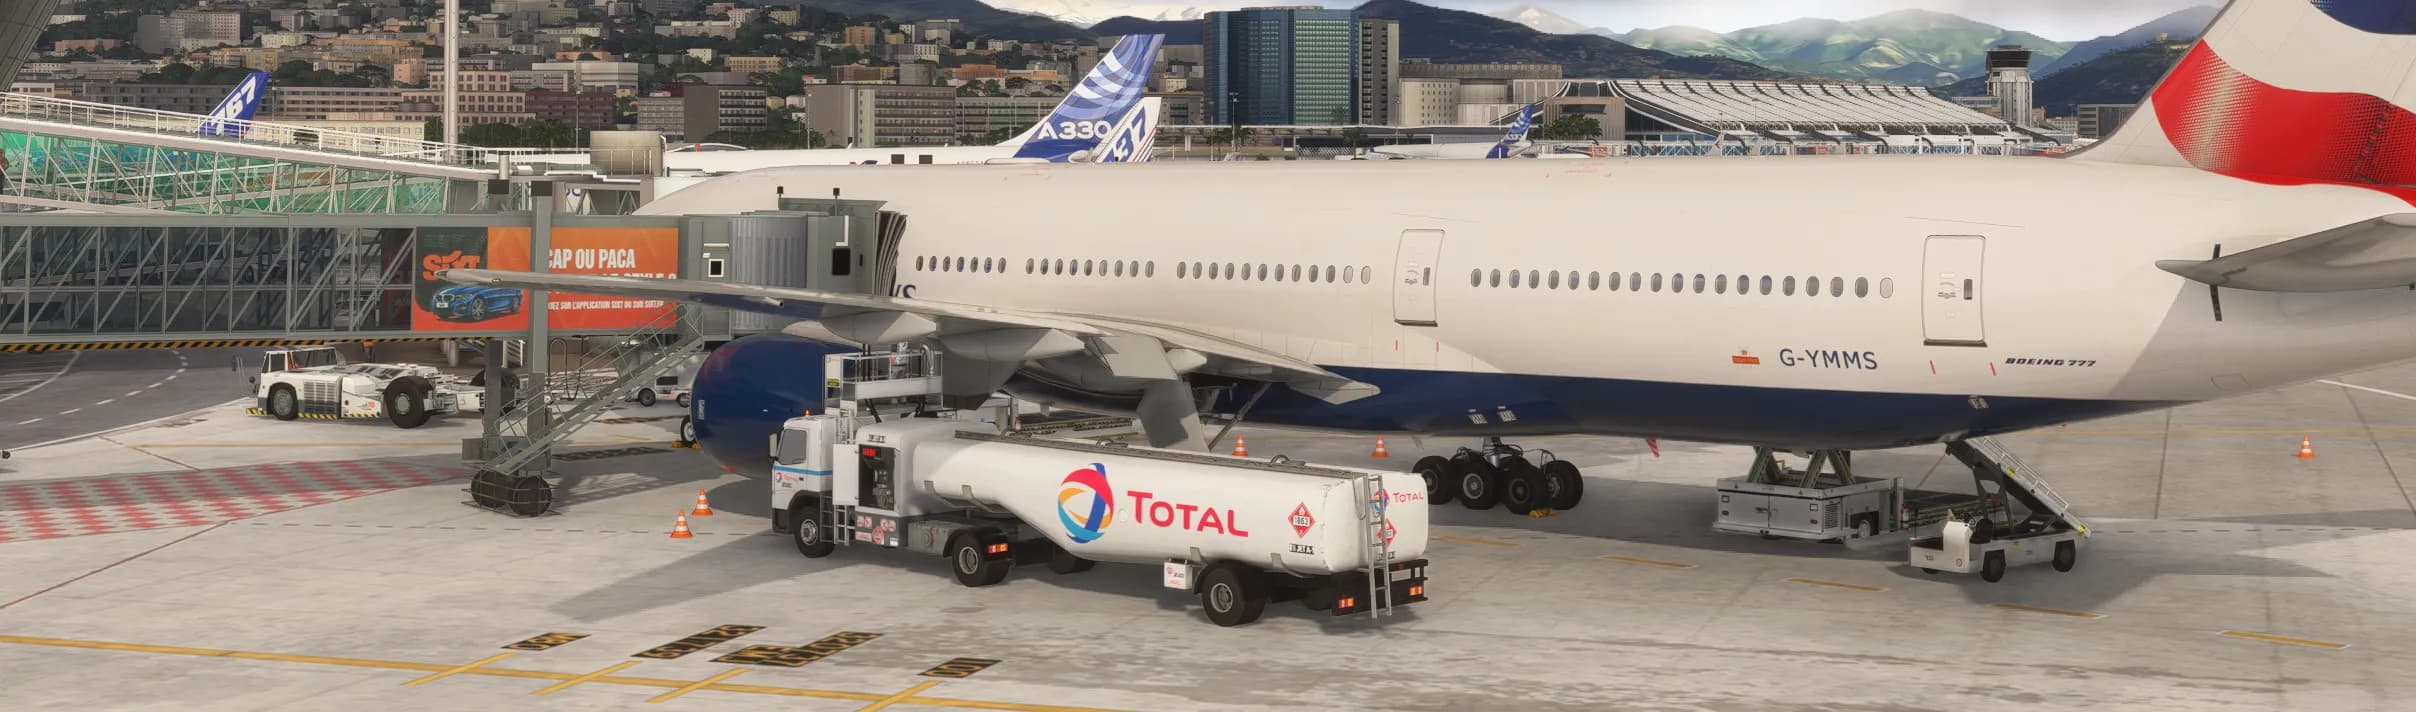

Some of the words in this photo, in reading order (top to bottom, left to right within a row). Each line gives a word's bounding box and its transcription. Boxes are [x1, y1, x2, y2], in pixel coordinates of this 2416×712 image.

[210, 75, 257, 136] 767
[1037, 120, 1113, 140] A330
[575, 248, 595, 269] OU
[598, 248, 636, 268] PACA
[1779, 348, 1878, 370] G-YMMS
[2005, 357, 2065, 366] BOEING
[2067, 359, 2097, 367] 777
[1392, 492, 1424, 503] TOTAL
[1127, 490, 1249, 538] TOTAL
